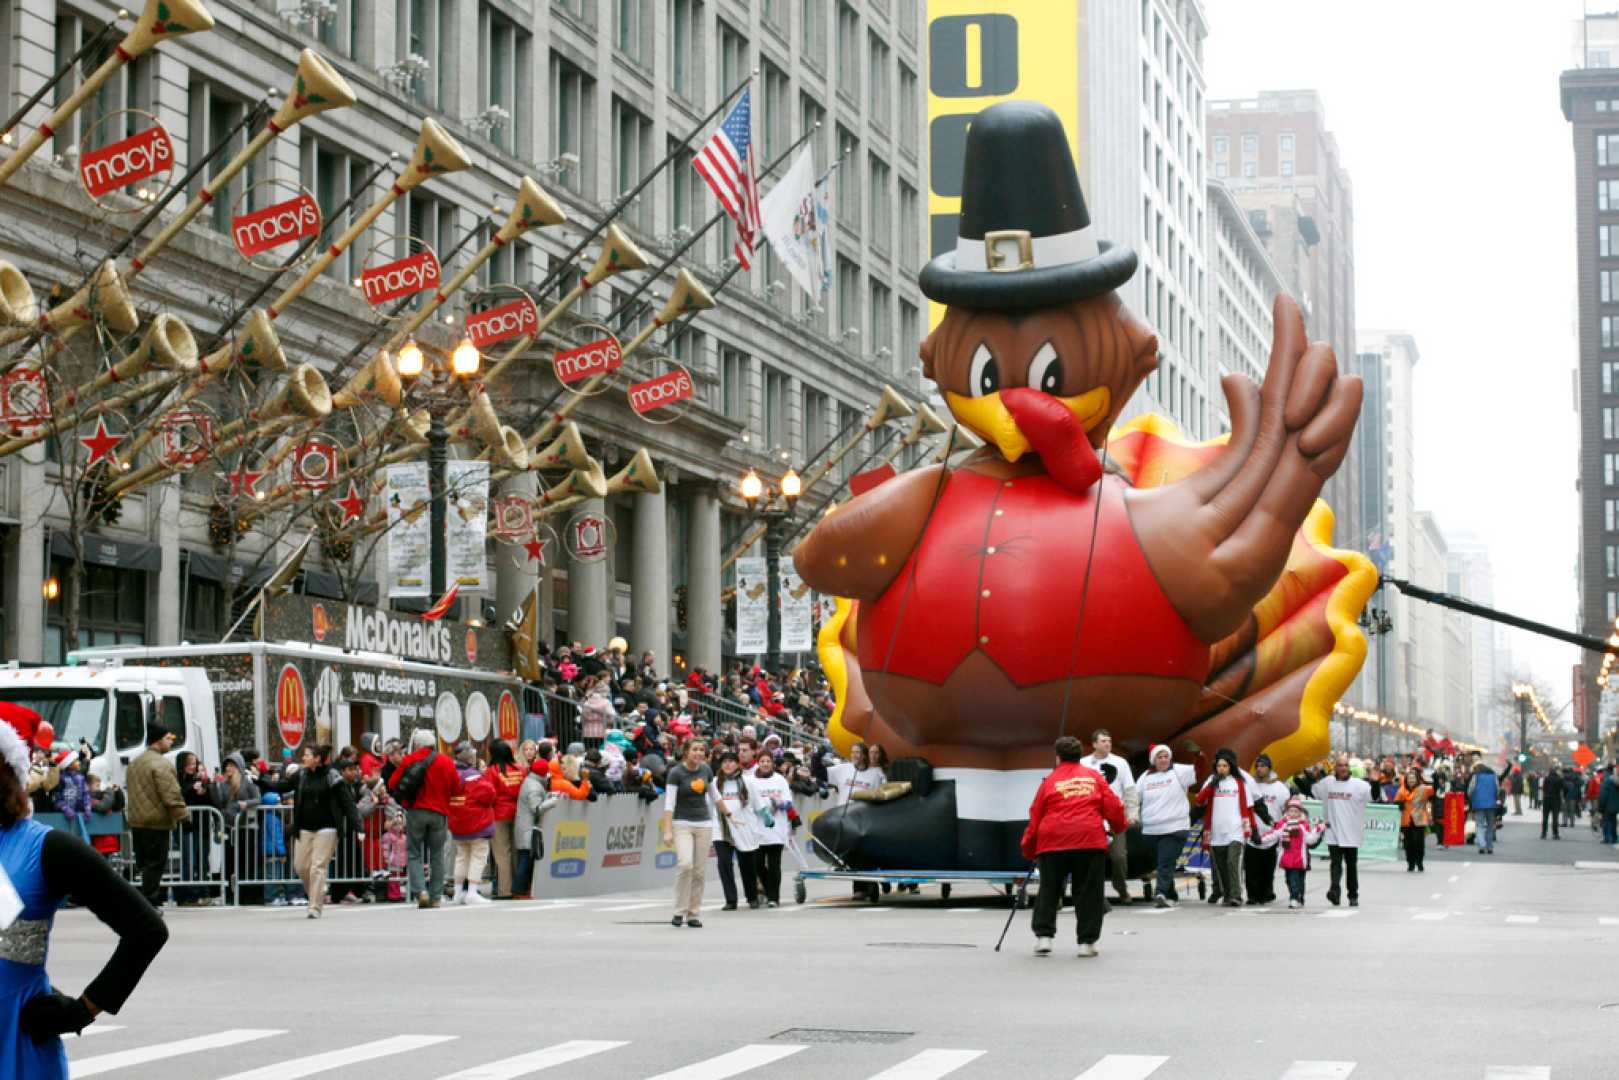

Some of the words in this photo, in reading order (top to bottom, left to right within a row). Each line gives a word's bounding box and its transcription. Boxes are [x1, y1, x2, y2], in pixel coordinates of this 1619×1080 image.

[84, 131, 171, 188] macy's
[236, 199, 318, 249] macy's
[364, 256, 436, 298] macy's
[469, 301, 535, 339] macy's
[556, 340, 620, 377] macy's
[632, 373, 690, 407] macy's
[346, 606, 451, 662] McDonald's
[353, 671, 375, 694] you
[378, 671, 426, 696] deserve
[428, 680, 435, 697] a
[606, 825, 636, 850] CASE
